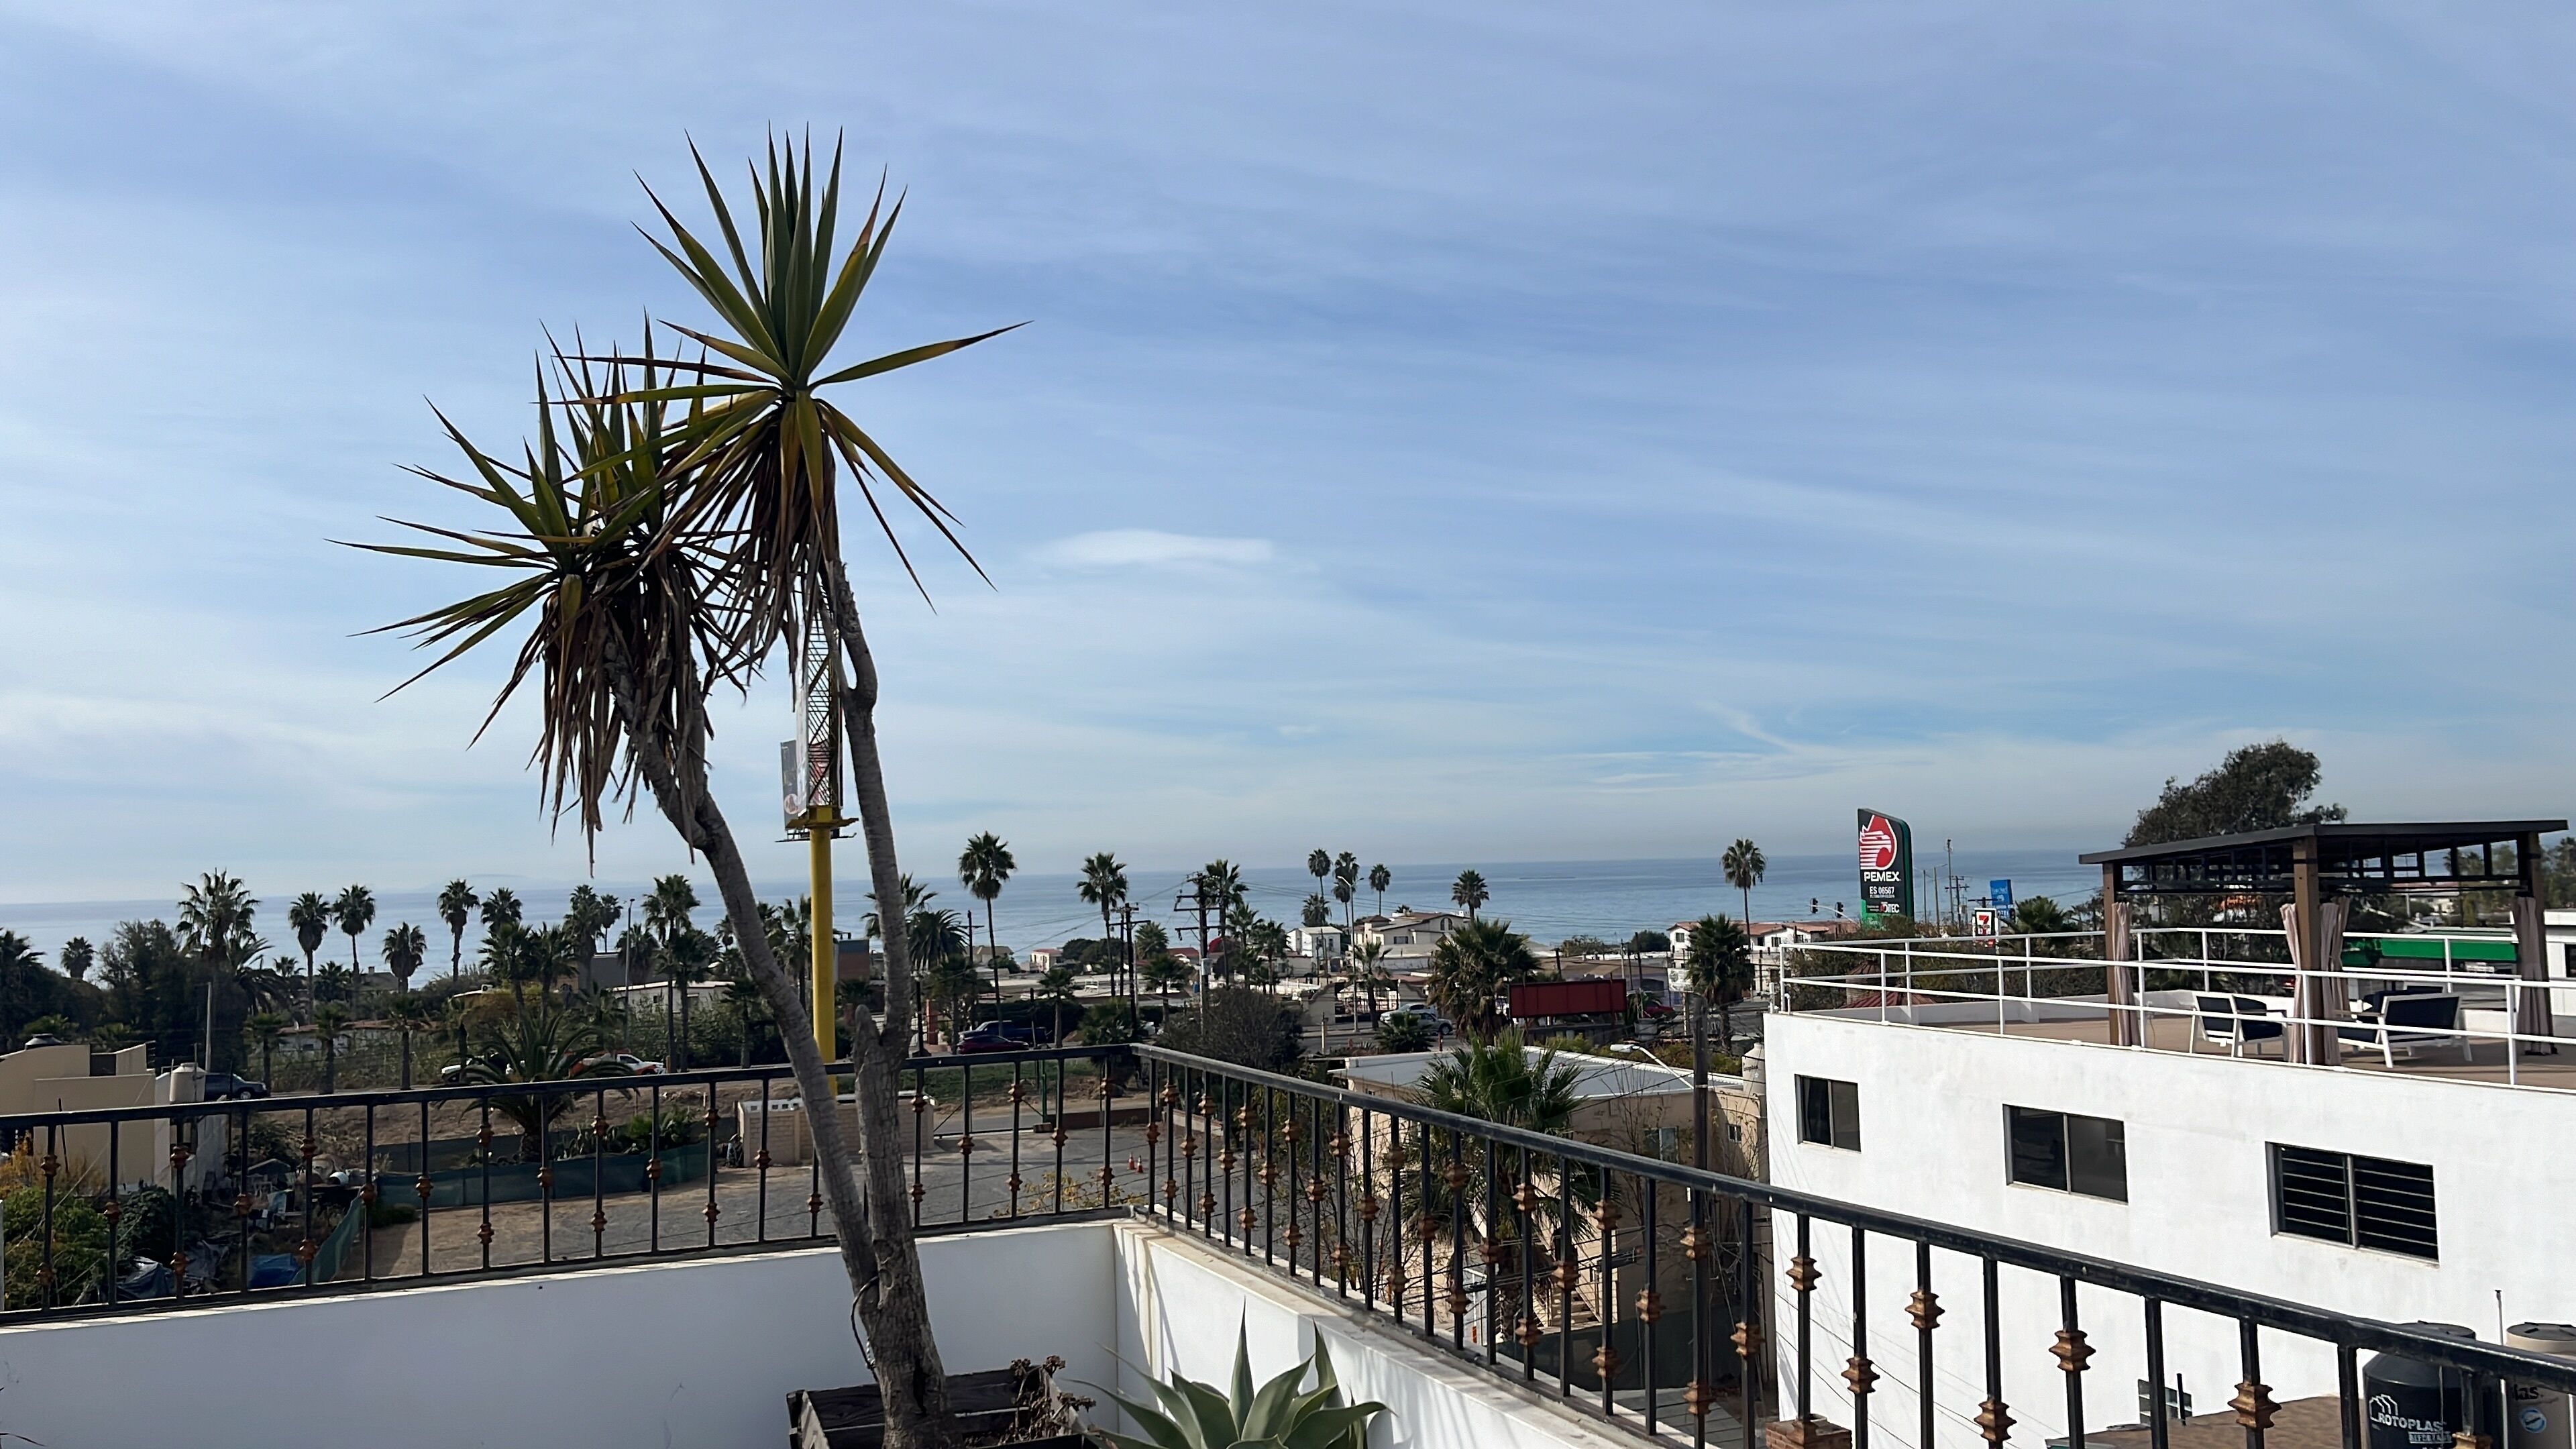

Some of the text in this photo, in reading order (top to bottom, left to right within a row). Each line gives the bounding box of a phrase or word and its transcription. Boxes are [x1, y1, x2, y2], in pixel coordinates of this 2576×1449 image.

[1864, 871, 1900, 882] PEMEX
[1870, 886, 1878, 894] ES
[2378, 1412, 2447, 1432] ROTOPLAS
